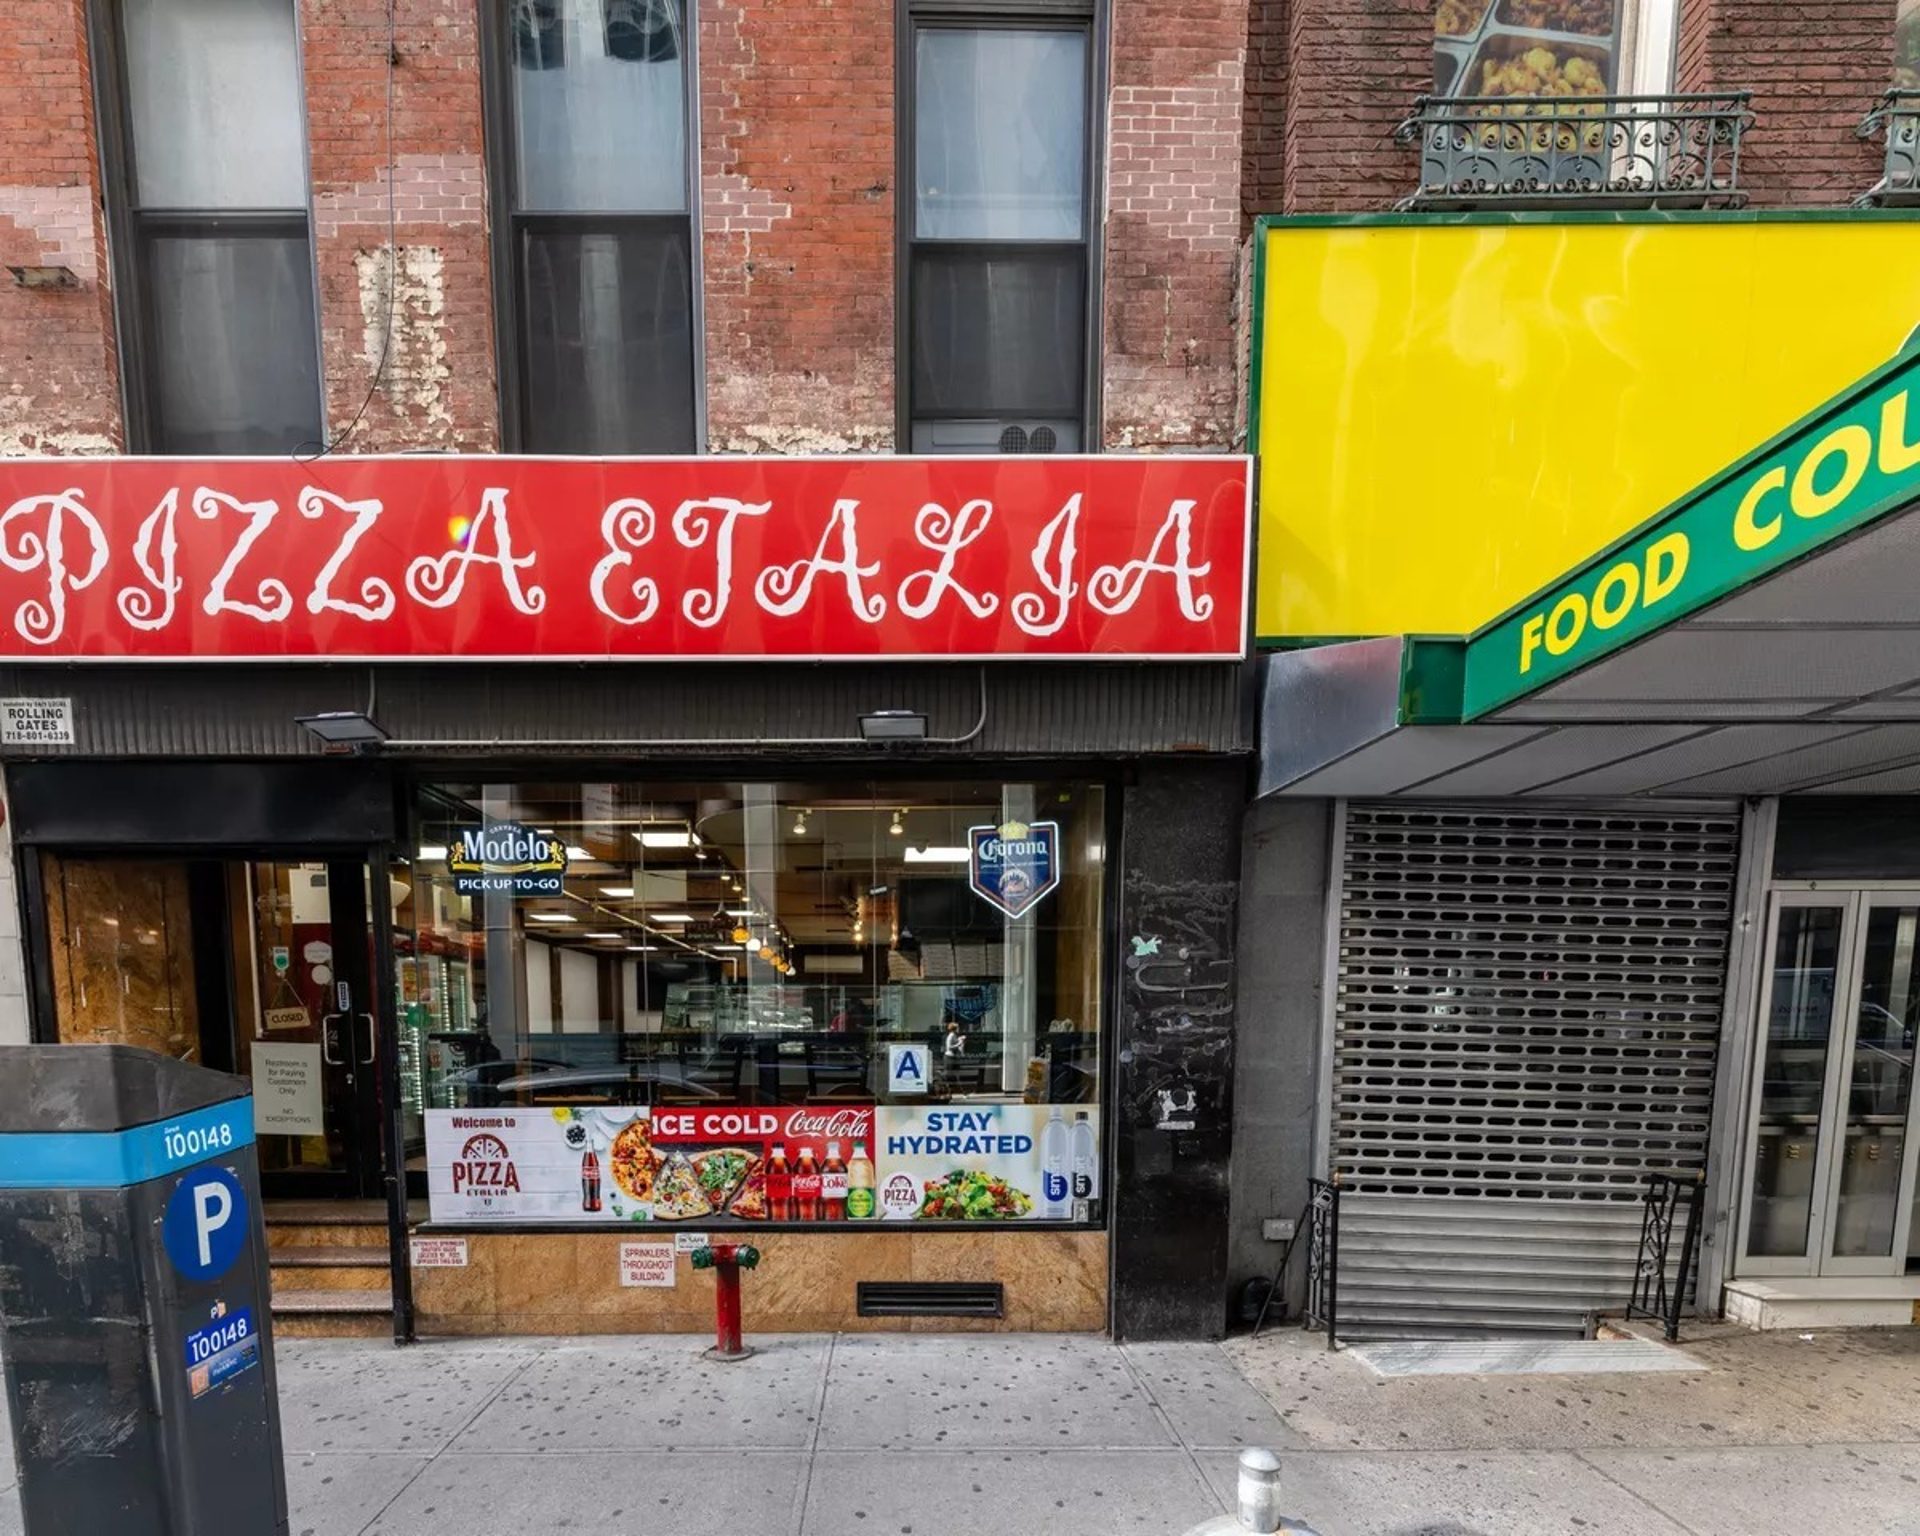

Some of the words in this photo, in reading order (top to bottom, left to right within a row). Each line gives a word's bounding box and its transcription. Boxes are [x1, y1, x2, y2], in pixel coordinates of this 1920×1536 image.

[0, 486, 546, 645] PIZZA
[590, 493, 1214, 637] ETALIA
[1519, 532, 1690, 675] FOOD
[8, 708, 64, 719] ROLLING
[15, 720, 58, 731] GATES
[463, 831, 550, 861] Modelo
[978, 839, 1049, 863] Corona
[459, 879, 492, 889] PICK
[494, 879, 512, 889] UP
[514, 879, 559, 889] TO-GO
[271, 1012, 304, 1024] CLOSED
[896, 1051, 920, 1078] A
[452, 1117, 502, 1128] Welcome
[505, 1117, 516, 1128] to
[652, 1115, 695, 1135] ICE
[703, 1115, 778, 1135] COLD
[785, 1110, 873, 1138] Coca-Cola
[927, 1113, 993, 1131] STAY
[164, 1123, 232, 1159] 100148
[888, 1136, 1032, 1154] HYDRATED
[452, 1161, 520, 1193] PIZZA
[884, 1188, 917, 1205] PIZZA
[193, 1181, 232, 1267] P
[624, 1248, 670, 1258] SPRINKLERS
[623, 1260, 673, 1270] THROUGHOUT
[631, 1271, 665, 1281] BUILDING
[192, 1318, 247, 1362] 100148
